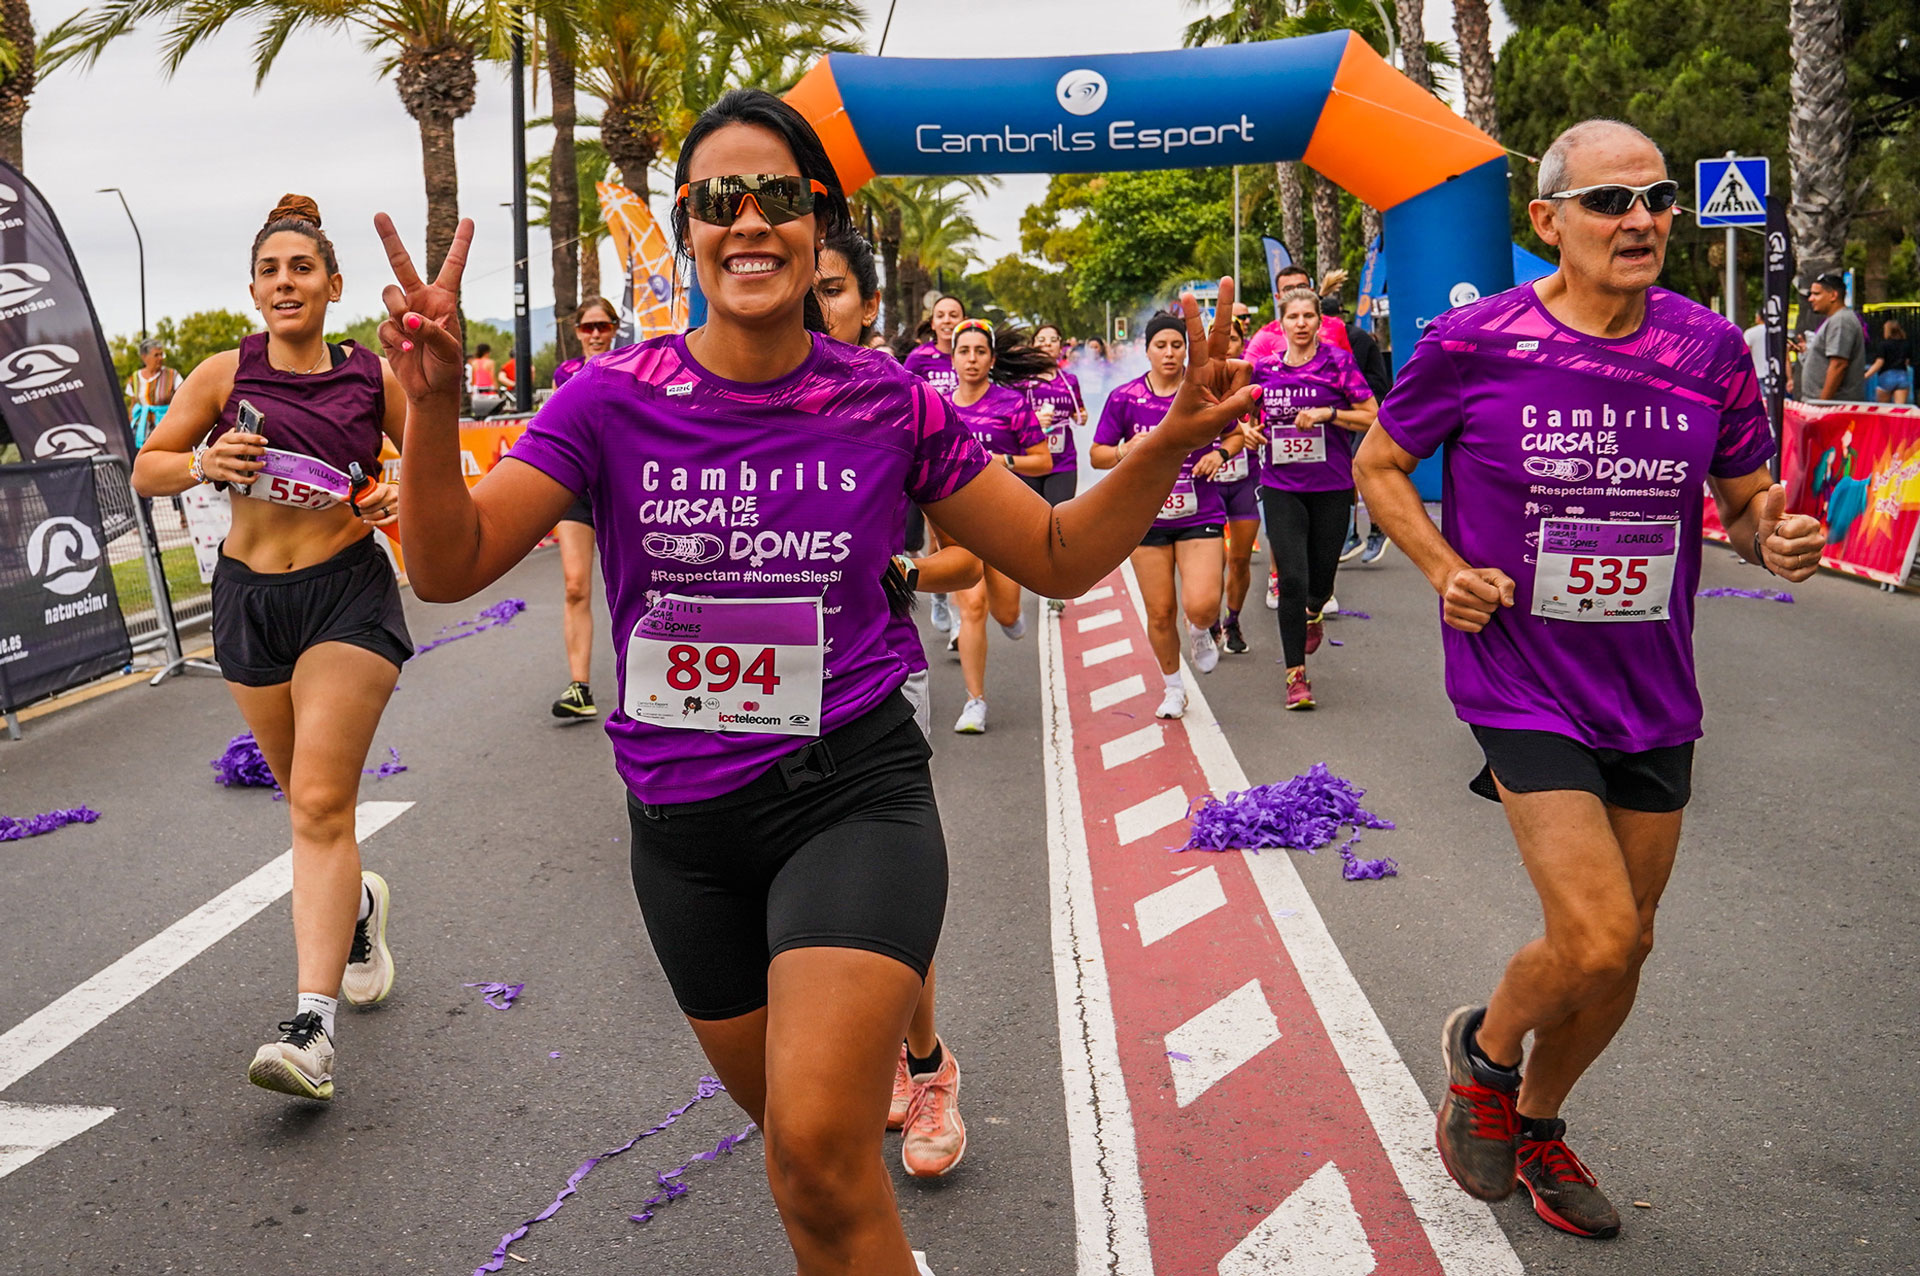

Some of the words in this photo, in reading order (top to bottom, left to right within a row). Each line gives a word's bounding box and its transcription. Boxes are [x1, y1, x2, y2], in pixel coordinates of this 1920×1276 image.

[915, 123, 1096, 153] Cambrils
[1108, 114, 1254, 154] Esport
[1522, 403, 1689, 431] Cambrils
[1283, 438, 1313, 453] 352
[1521, 431, 1595, 454] CURSA
[1597, 430, 1617, 444] DE
[1596, 444, 1619, 455] LES
[1219, 460, 1236, 473] 91
[1595, 457, 1689, 485] DONES
[642, 460, 857, 492] Cambrils
[1530, 485, 1604, 498] #Respectam
[639, 497, 728, 528] CURSA
[732, 496, 757, 513] DE
[730, 513, 760, 527] LES
[1616, 533, 1664, 544] J.CARLOS
[729, 530, 852, 569] DONES
[651, 569, 741, 584] #Respectam
[1566, 556, 1648, 596] 535
[1603, 608, 1646, 617] icctelecom
[664, 621, 702, 633] DONES
[666, 643, 781, 695] 894
[718, 711, 781, 726] icctelecom
